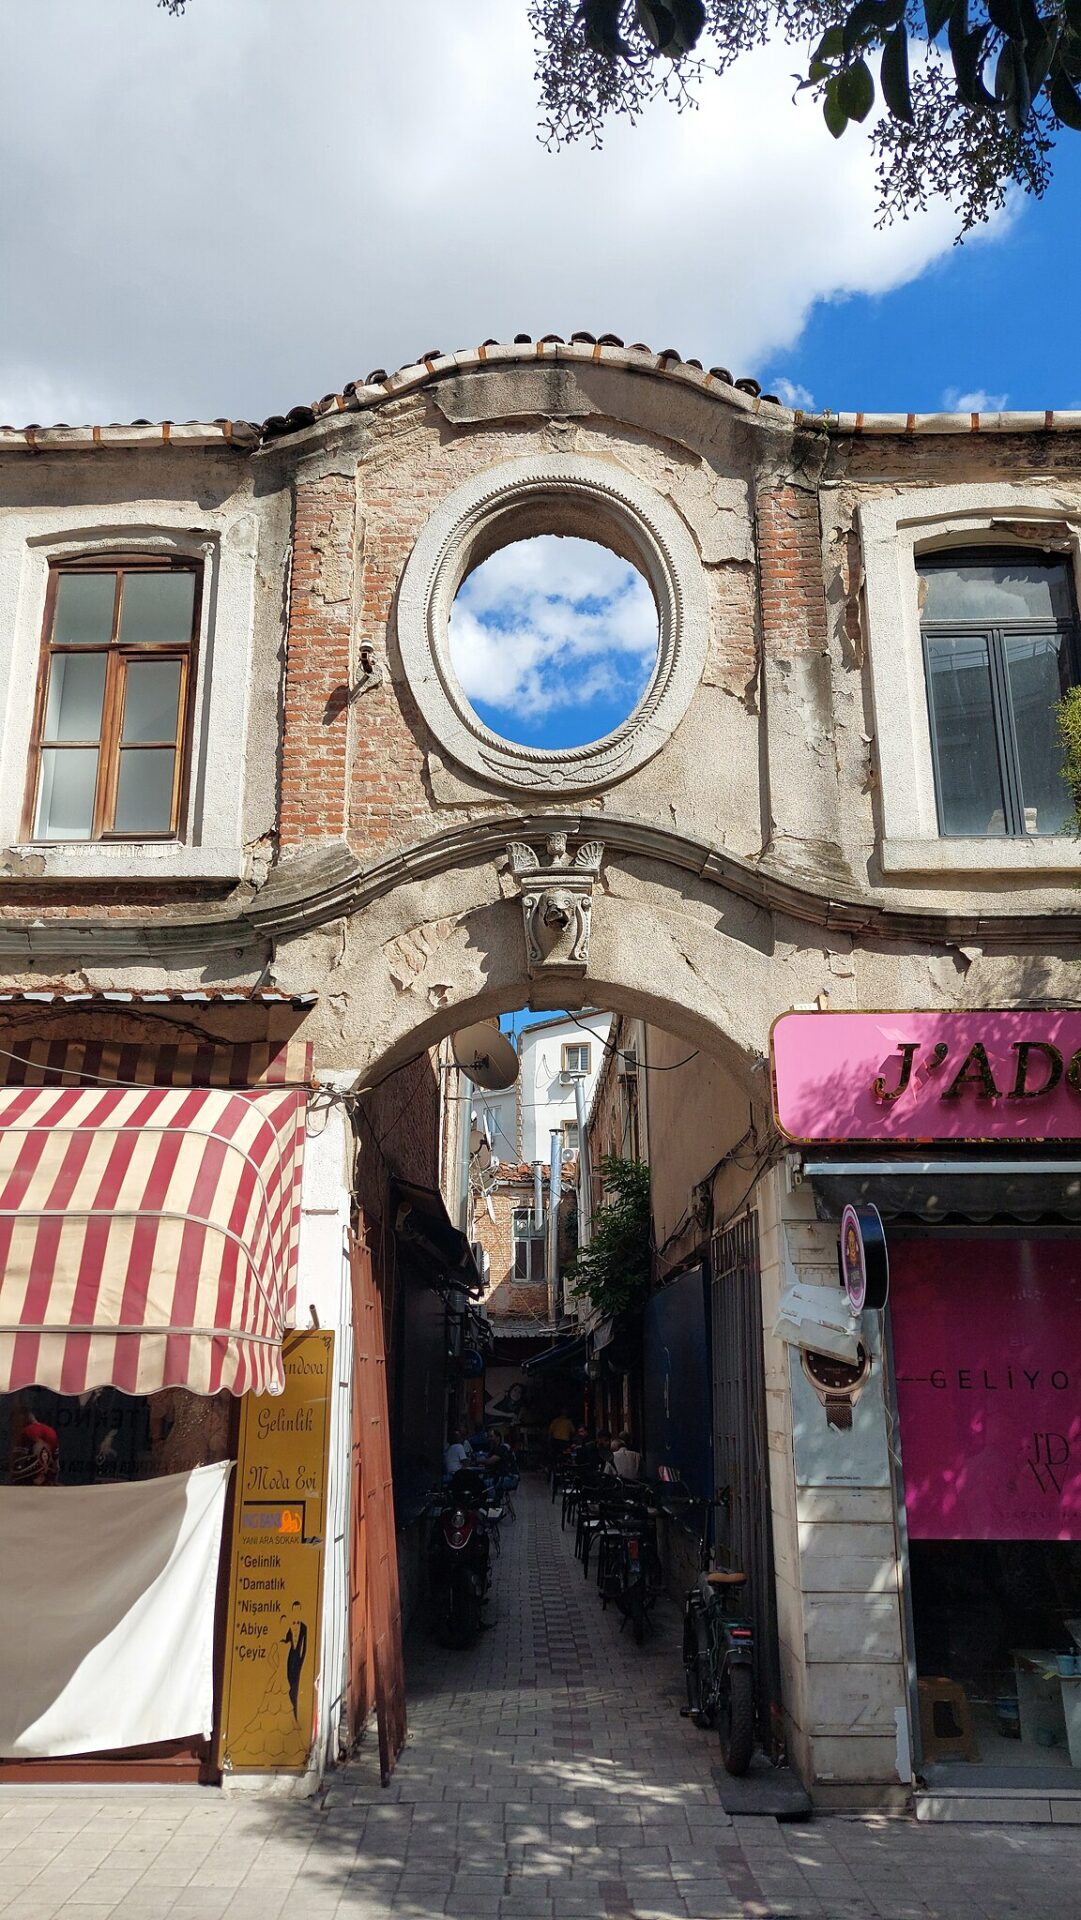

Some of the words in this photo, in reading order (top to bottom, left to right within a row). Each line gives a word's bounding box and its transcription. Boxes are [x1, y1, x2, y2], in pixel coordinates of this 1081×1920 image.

[258, 1408, 313, 1439] Gelinlik
[248, 1466, 290, 1490] Moda
[296, 1465, 317, 1490] Evi
[260, 1536, 274, 1544] ARA
[275, 1536, 300, 1544] SOKAK
